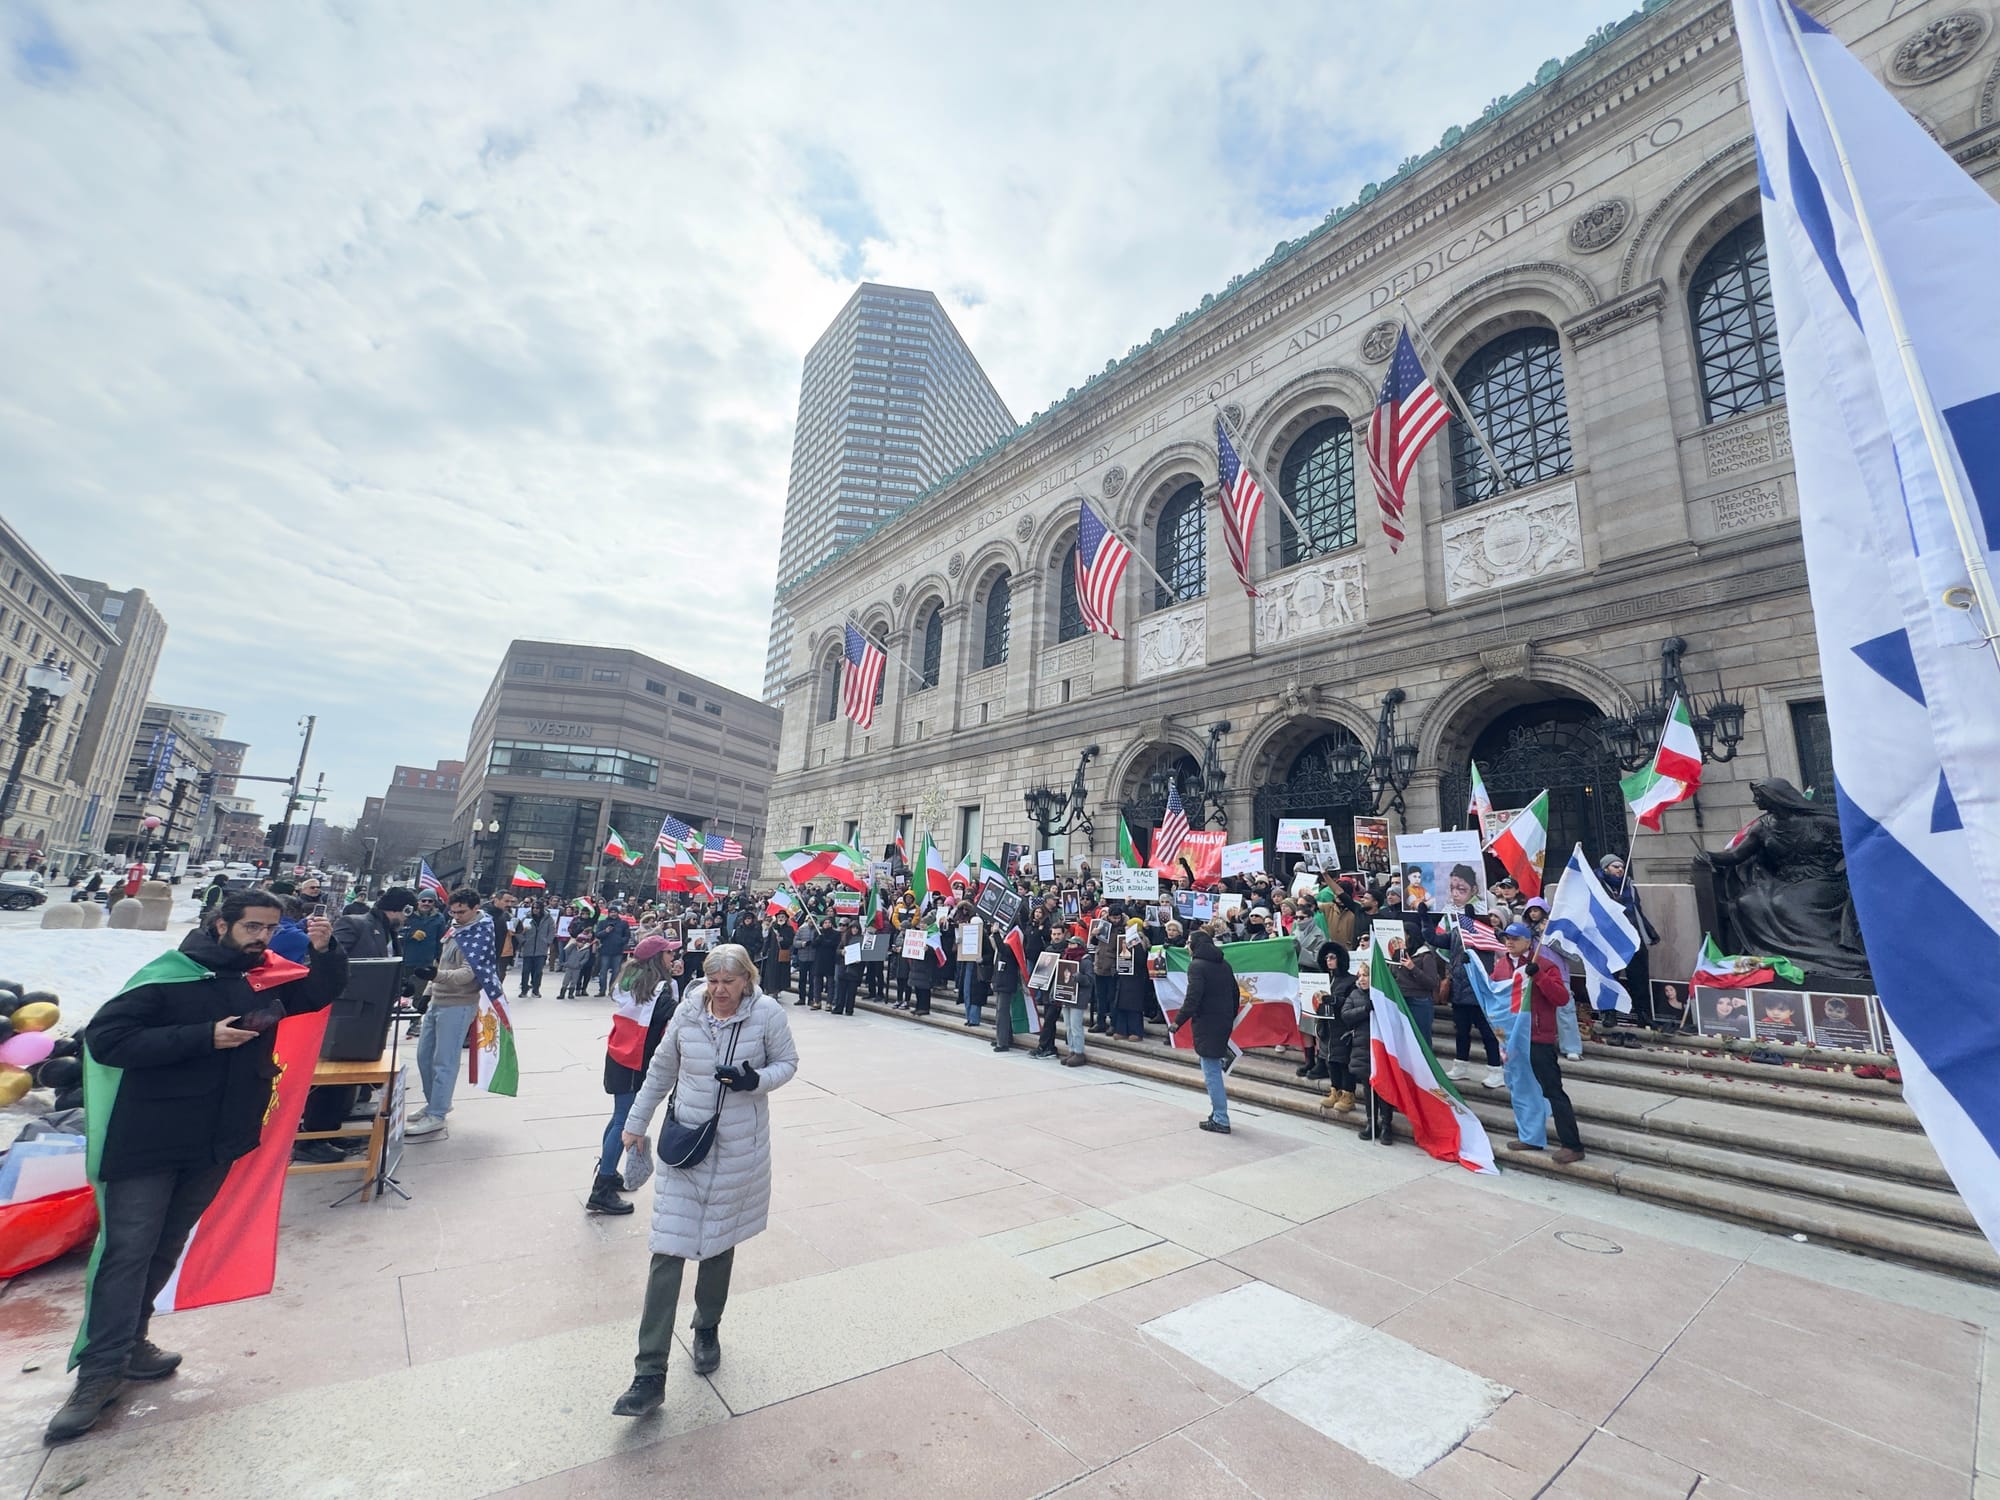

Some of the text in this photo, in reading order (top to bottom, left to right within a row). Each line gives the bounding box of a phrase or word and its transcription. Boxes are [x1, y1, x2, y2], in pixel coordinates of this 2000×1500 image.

[955, 525, 971, 542] OF
[977, 489, 1033, 529] BOSTON
[1040, 460, 1082, 494] BUILT
[1093, 441, 1115, 466] BY
[1129, 410, 1170, 443] THE
[1183, 355, 1266, 416] PEOPLE
[1285, 313, 1343, 358] AND
[1369, 180, 1576, 310] DEDICATED
[1616, 118, 1684, 163] TO
[1707, 424, 1751, 443] HOMER
[1708, 431, 1754, 452] SAPPHO
[1709, 435, 1769, 460] ANACREON
[1711, 454, 1771, 478] SIMONIDES
[1717, 487, 1761, 505] HESIOD
[1718, 501, 1780, 522] MENANDER
[1720, 510, 1777, 531] PLAVTVS
[527, 719, 593, 738] WESTIN
[154, 746, 173, 789] PARKING
[1133, 870, 1153, 878] PEACE
[1108, 885, 1125, 893] IRAN
